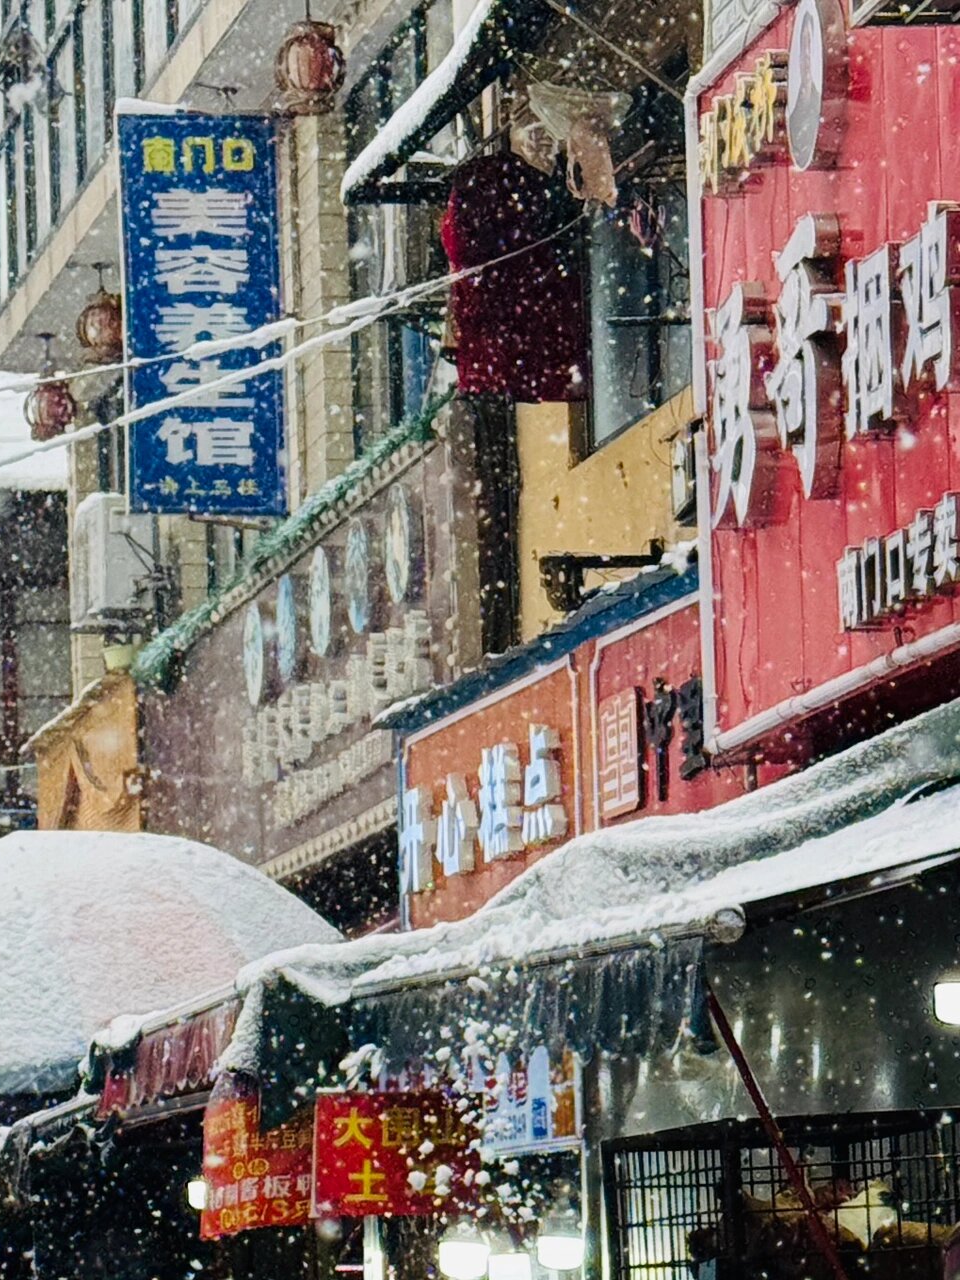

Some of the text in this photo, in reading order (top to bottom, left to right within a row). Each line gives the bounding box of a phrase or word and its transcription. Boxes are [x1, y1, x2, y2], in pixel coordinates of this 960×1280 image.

[143, 136, 254, 173] 南门口
[150, 187, 255, 467] 美容养生馆
